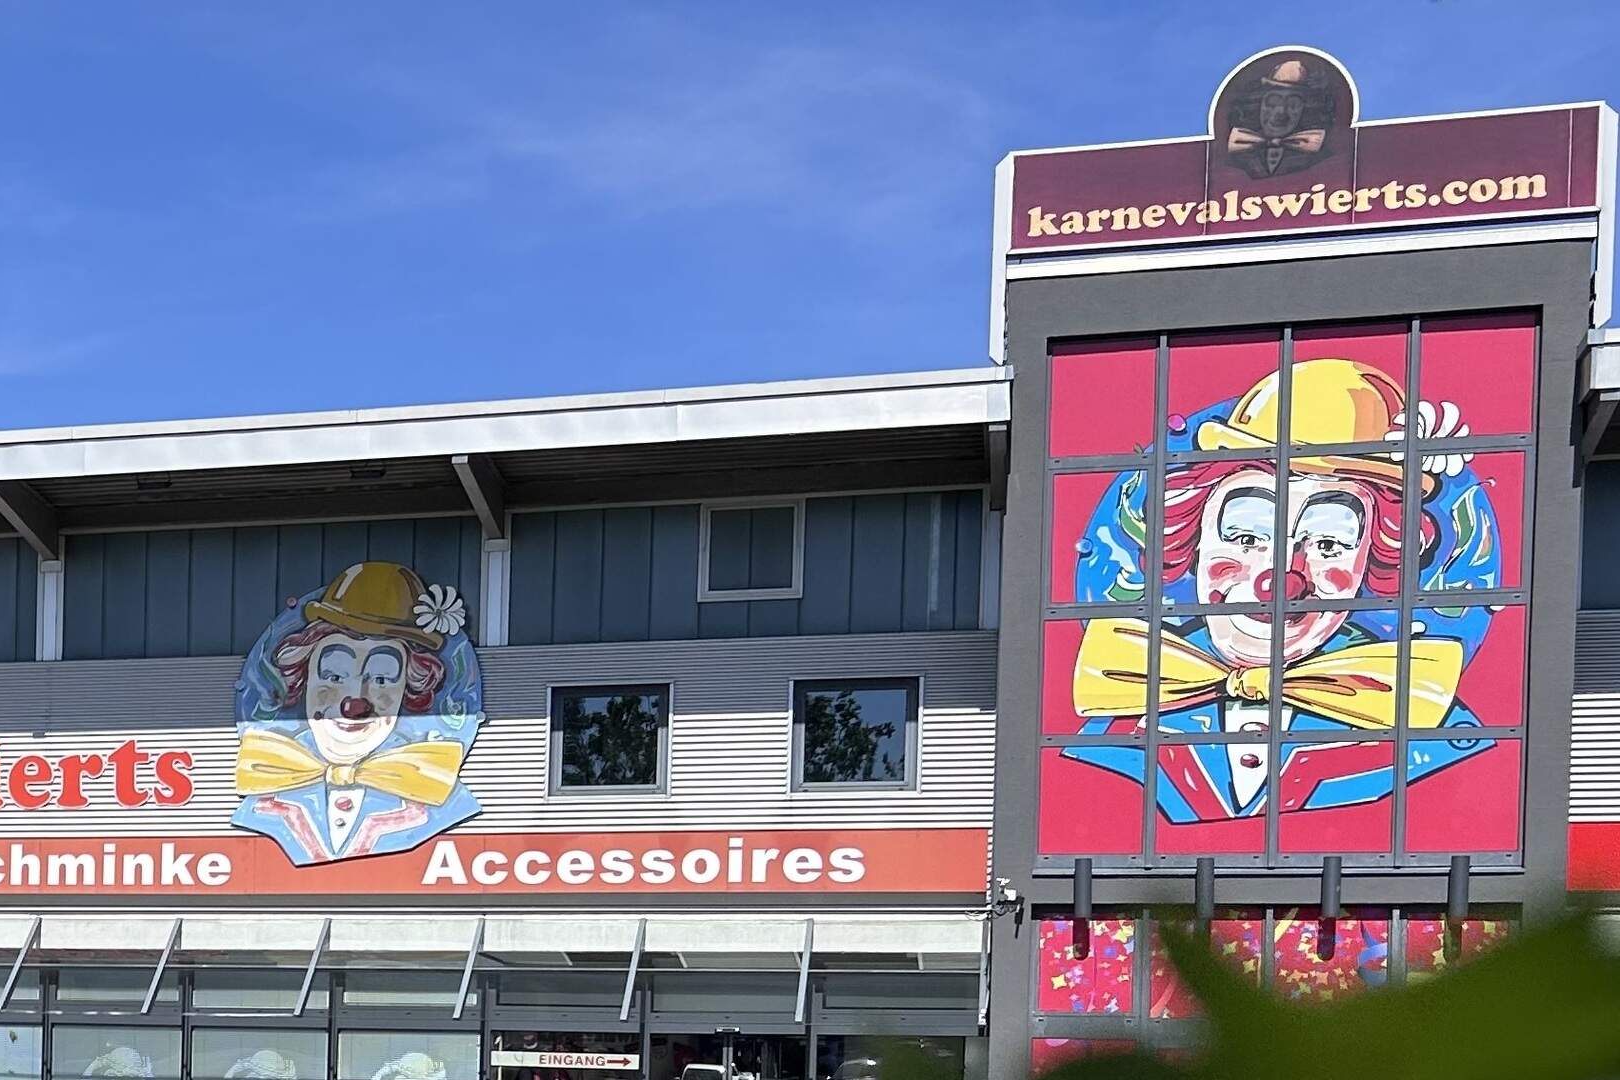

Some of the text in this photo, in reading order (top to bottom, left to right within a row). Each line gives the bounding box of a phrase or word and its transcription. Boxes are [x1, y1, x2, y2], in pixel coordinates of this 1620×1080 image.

[1028, 173, 1548, 238] karnevalswierts.com
[421, 838, 866, 886] Accessoires
[538, 1054, 606, 1066] EINGANG
